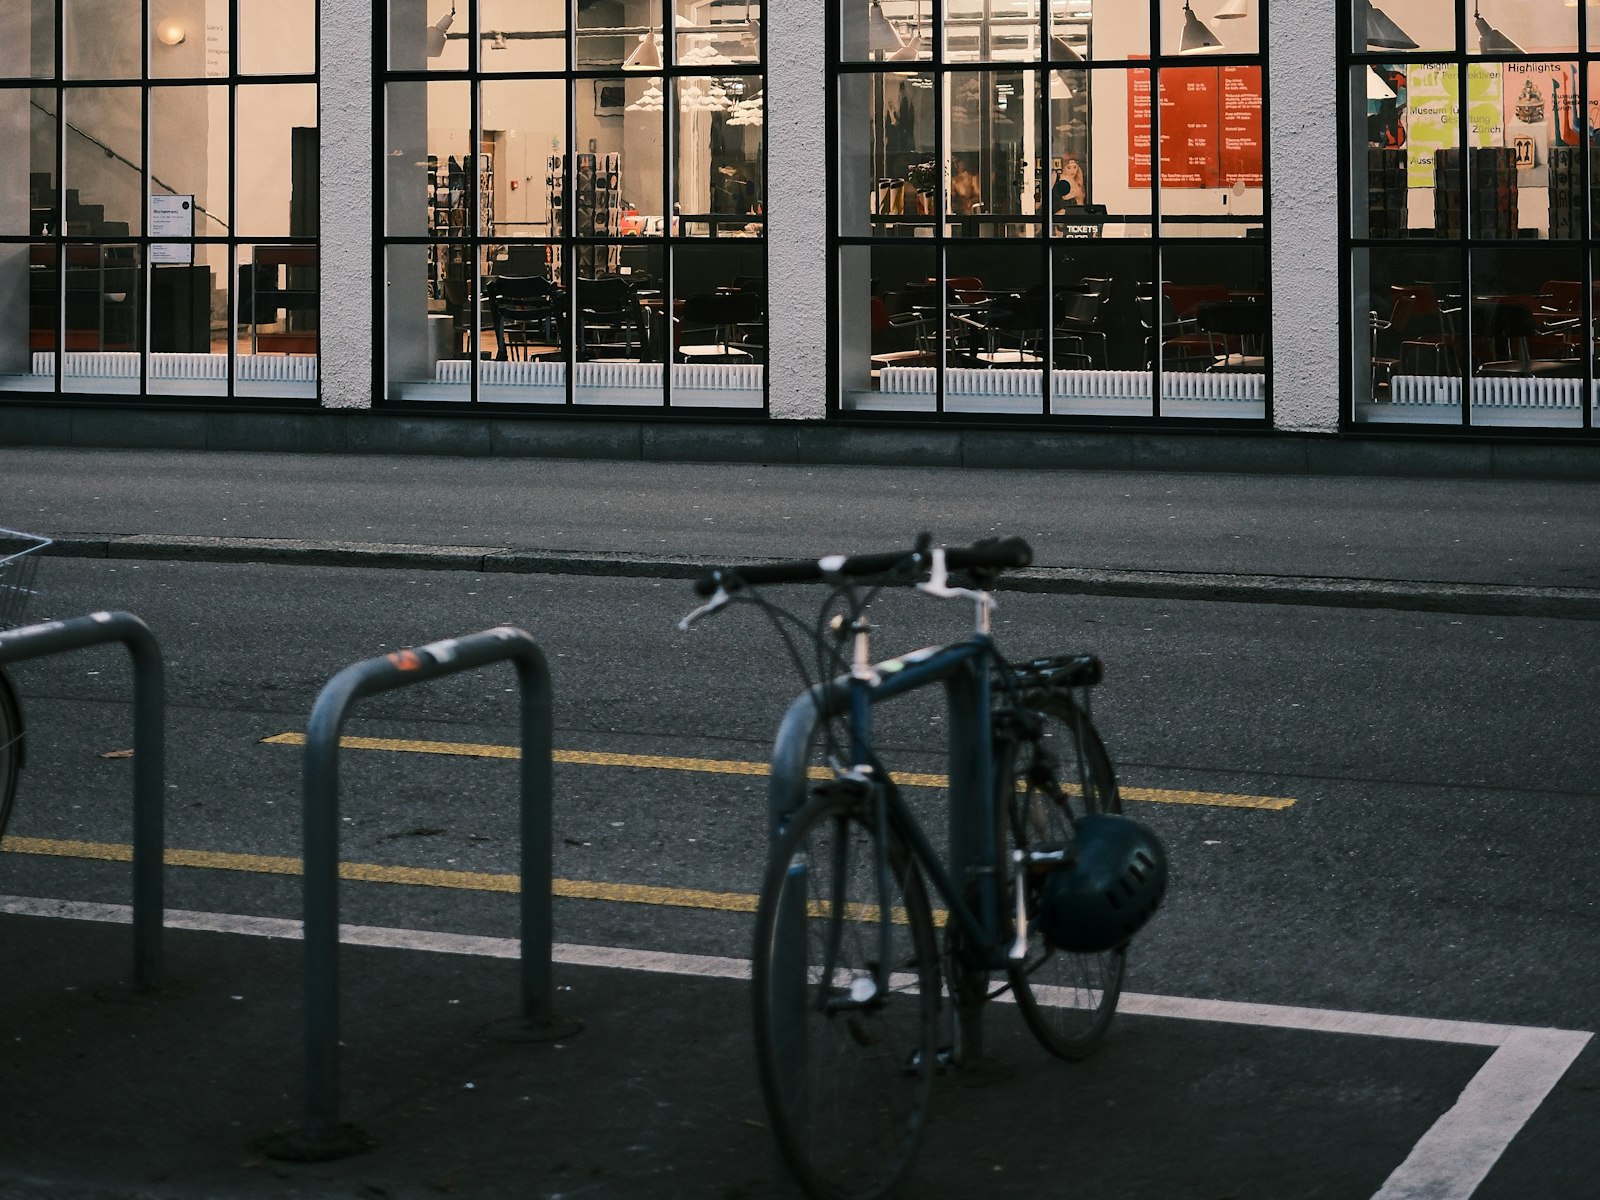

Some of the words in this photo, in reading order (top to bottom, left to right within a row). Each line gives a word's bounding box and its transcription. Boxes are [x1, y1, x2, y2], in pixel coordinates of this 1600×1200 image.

[1508, 63, 1561, 74] Highlights
[1442, 71, 1501, 80] Perektiven
[1410, 106, 1447, 115] Museum
[1440, 115, 1491, 125] Gestung
[1472, 125, 1501, 134] Zürich
[1066, 225, 1098, 233] TICKETS
